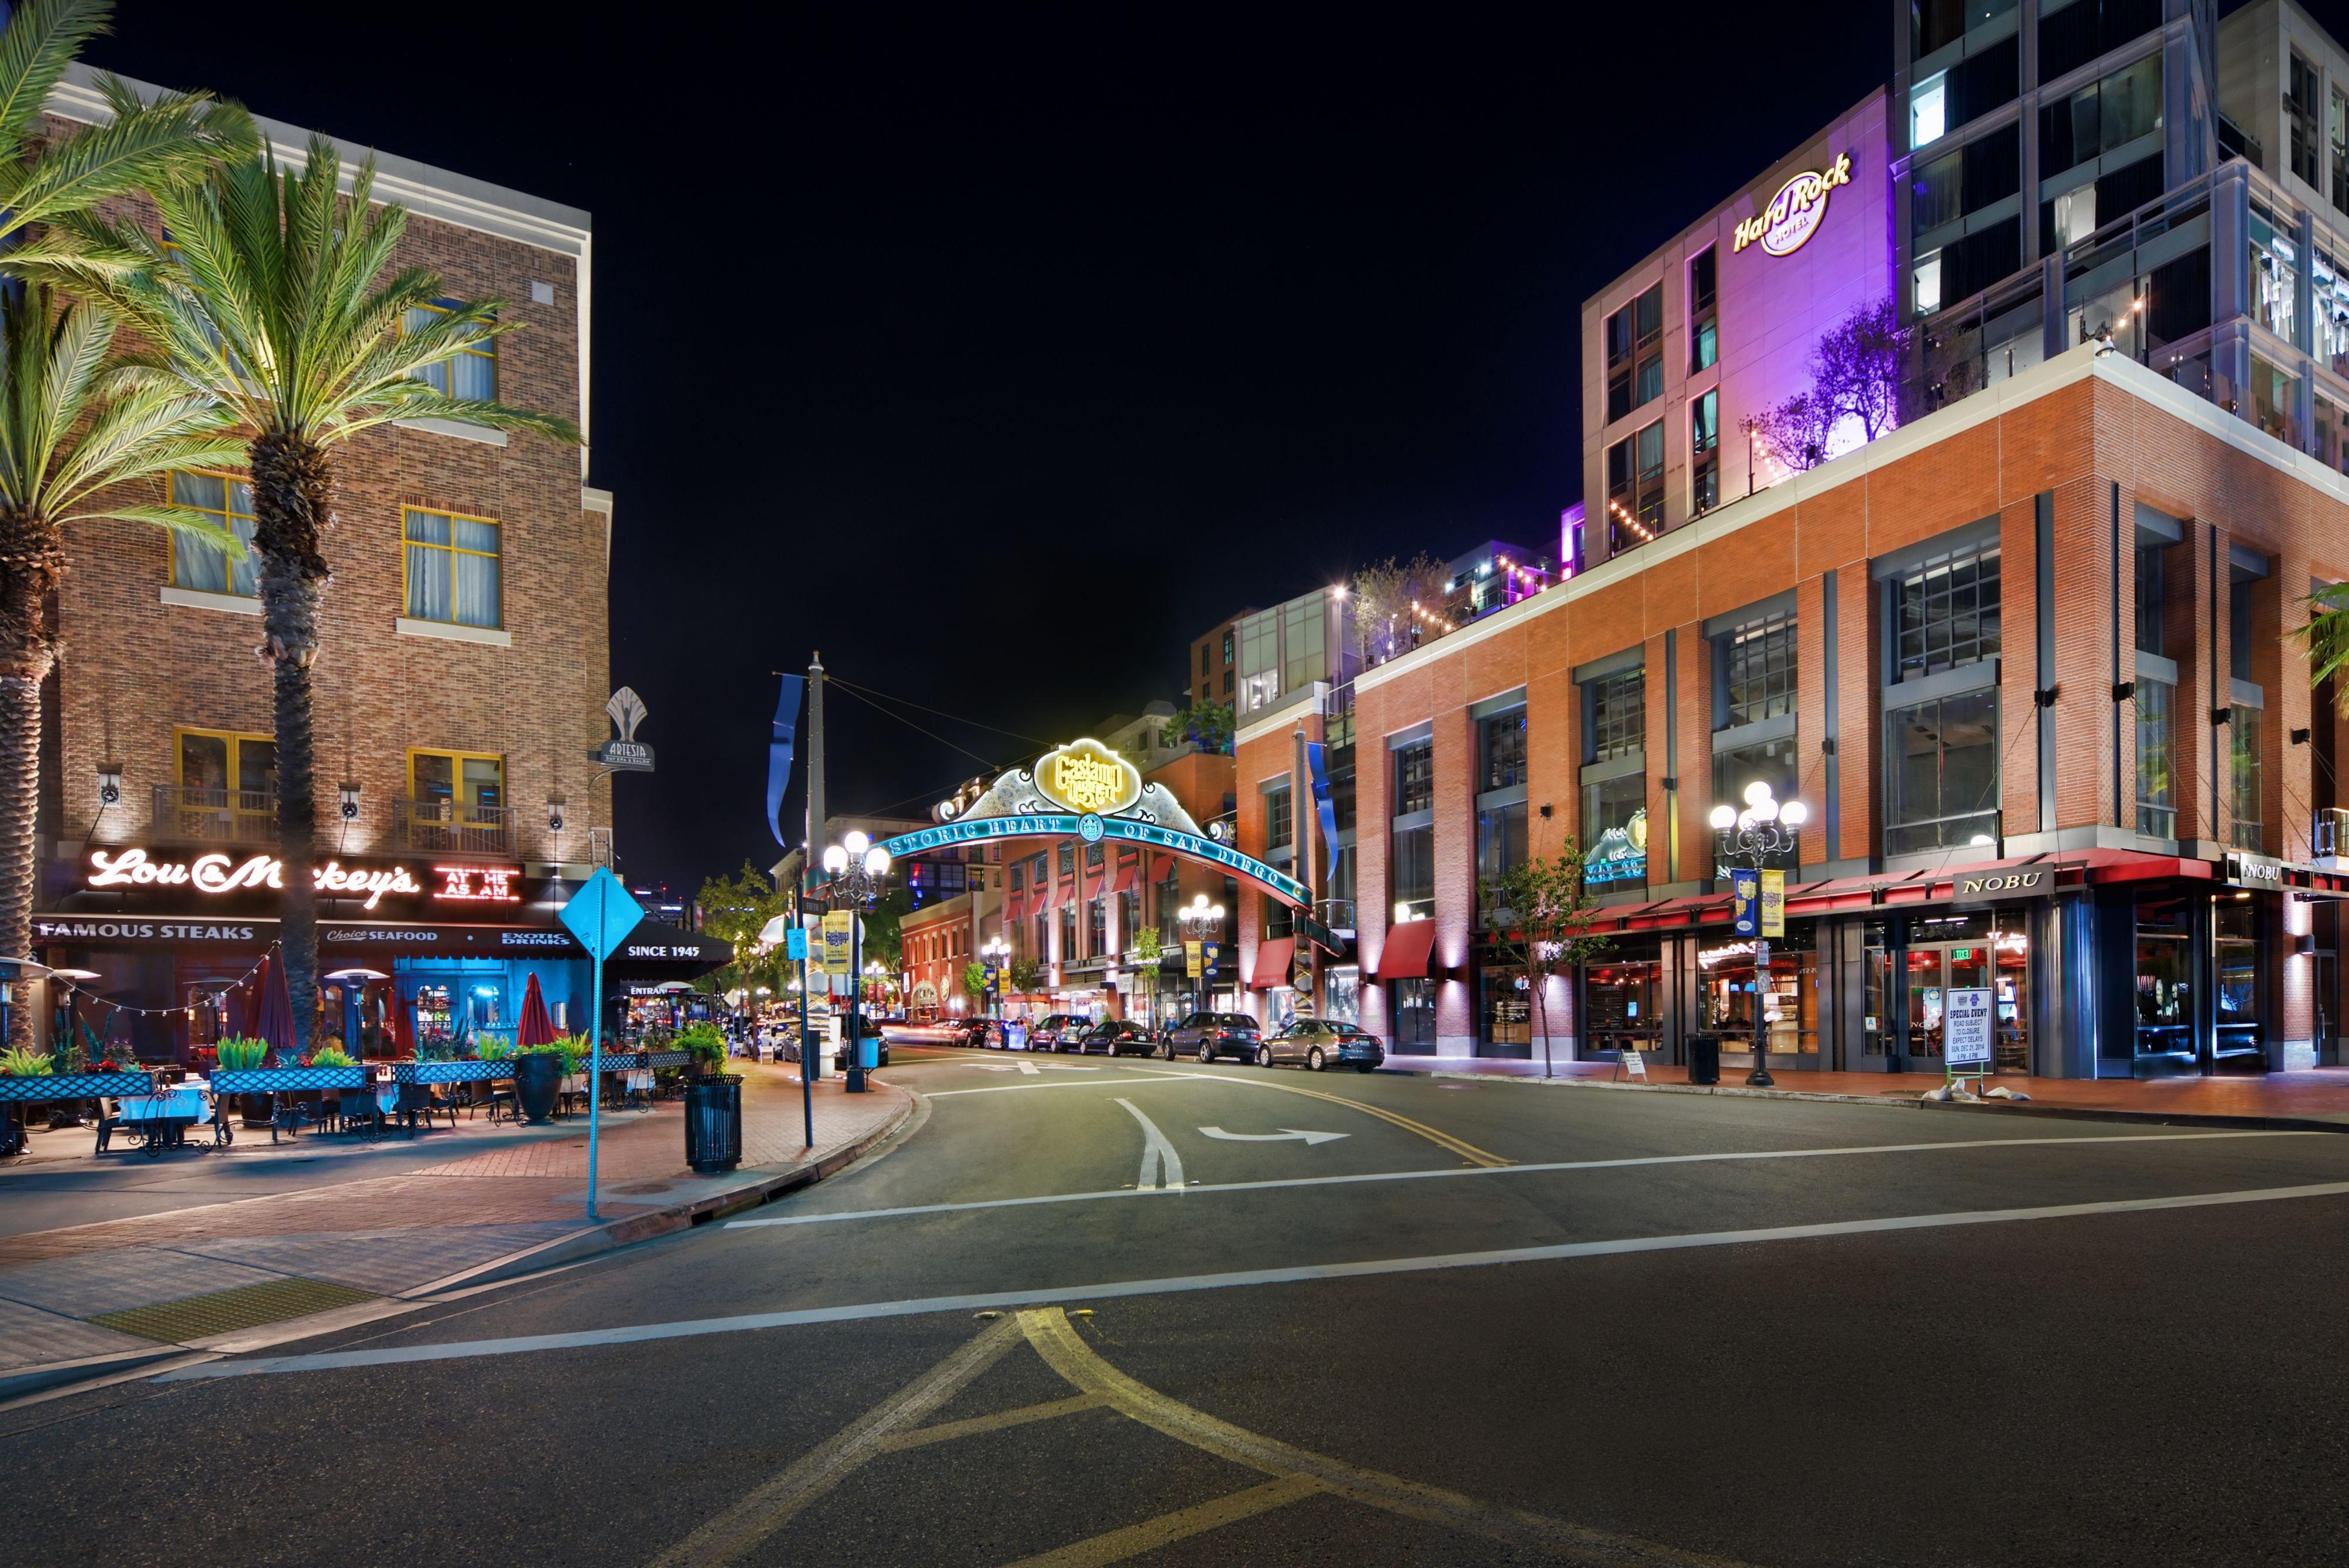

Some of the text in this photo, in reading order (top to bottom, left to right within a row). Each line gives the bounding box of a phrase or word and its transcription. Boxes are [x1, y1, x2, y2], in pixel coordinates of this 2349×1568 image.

[1734, 153, 1850, 253] Hard Rock
[1775, 217, 1809, 243] HOTEL
[609, 742, 647, 758] ARTESIA
[1055, 753, 1122, 792] Gaslamp
[889, 817, 1280, 885] STORIC HEART OF SAN DIEGO
[88, 848, 190, 886] Lou
[191, 854, 420, 910] Mkey's
[2247, 864, 2280, 880] NOBU
[1963, 872, 2042, 894] NOBU
[39, 923, 254, 940] FAMOUS STEAKS
[327, 930, 438, 941] Choice SEAFOOD
[628, 946, 700, 957] SINCE 1945
[630, 987, 668, 995] ENTRAN
[1950, 1008, 1987, 1019] SPECIAL EVENT
